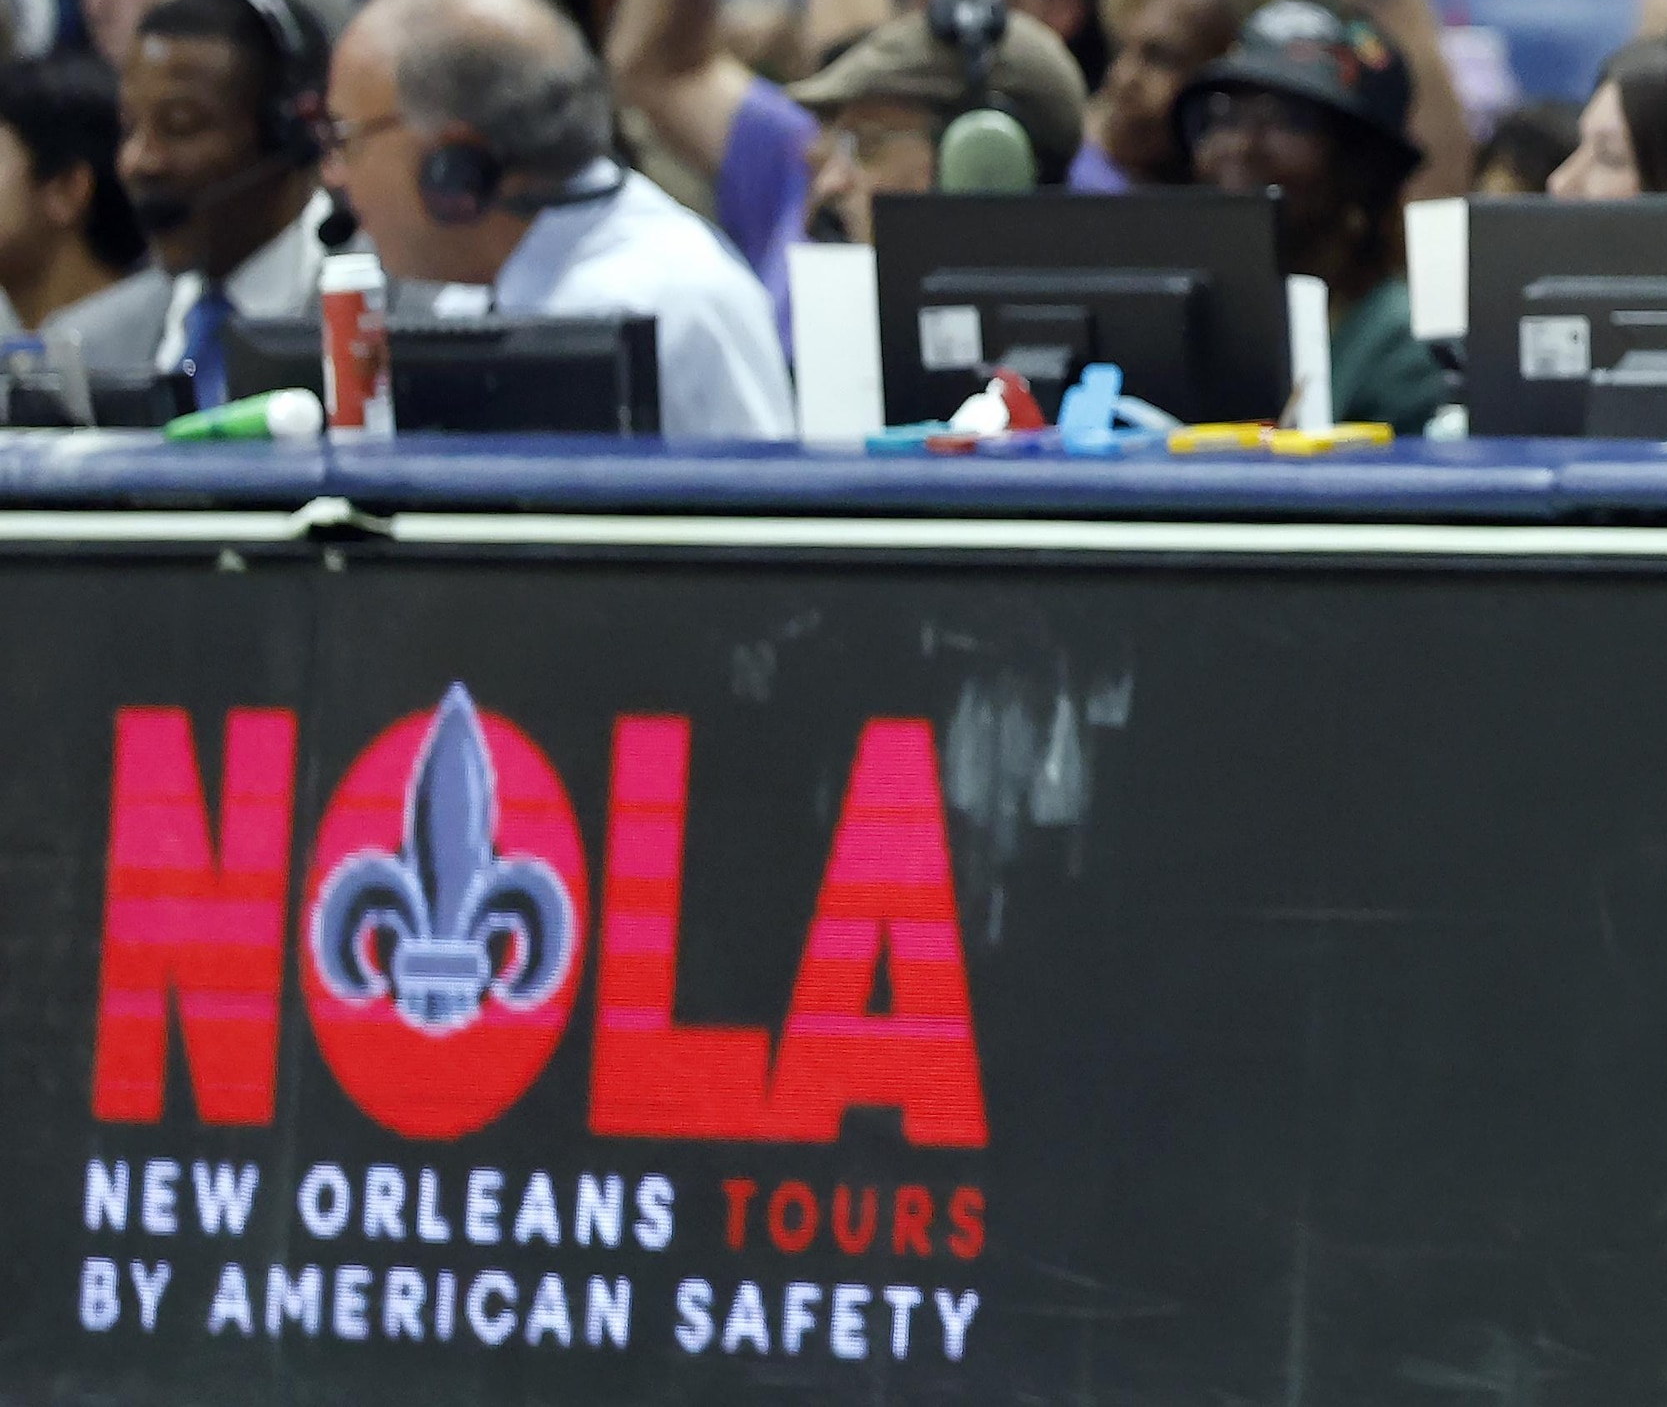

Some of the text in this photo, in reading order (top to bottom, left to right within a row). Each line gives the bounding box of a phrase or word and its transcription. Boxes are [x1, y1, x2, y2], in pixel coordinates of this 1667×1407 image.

[92, 706, 989, 1148] NOLA
[85, 1159, 985, 1260] NEW ORLEANS TOURS
[81, 1257, 979, 1360] BY AMERICAN SAFETY
